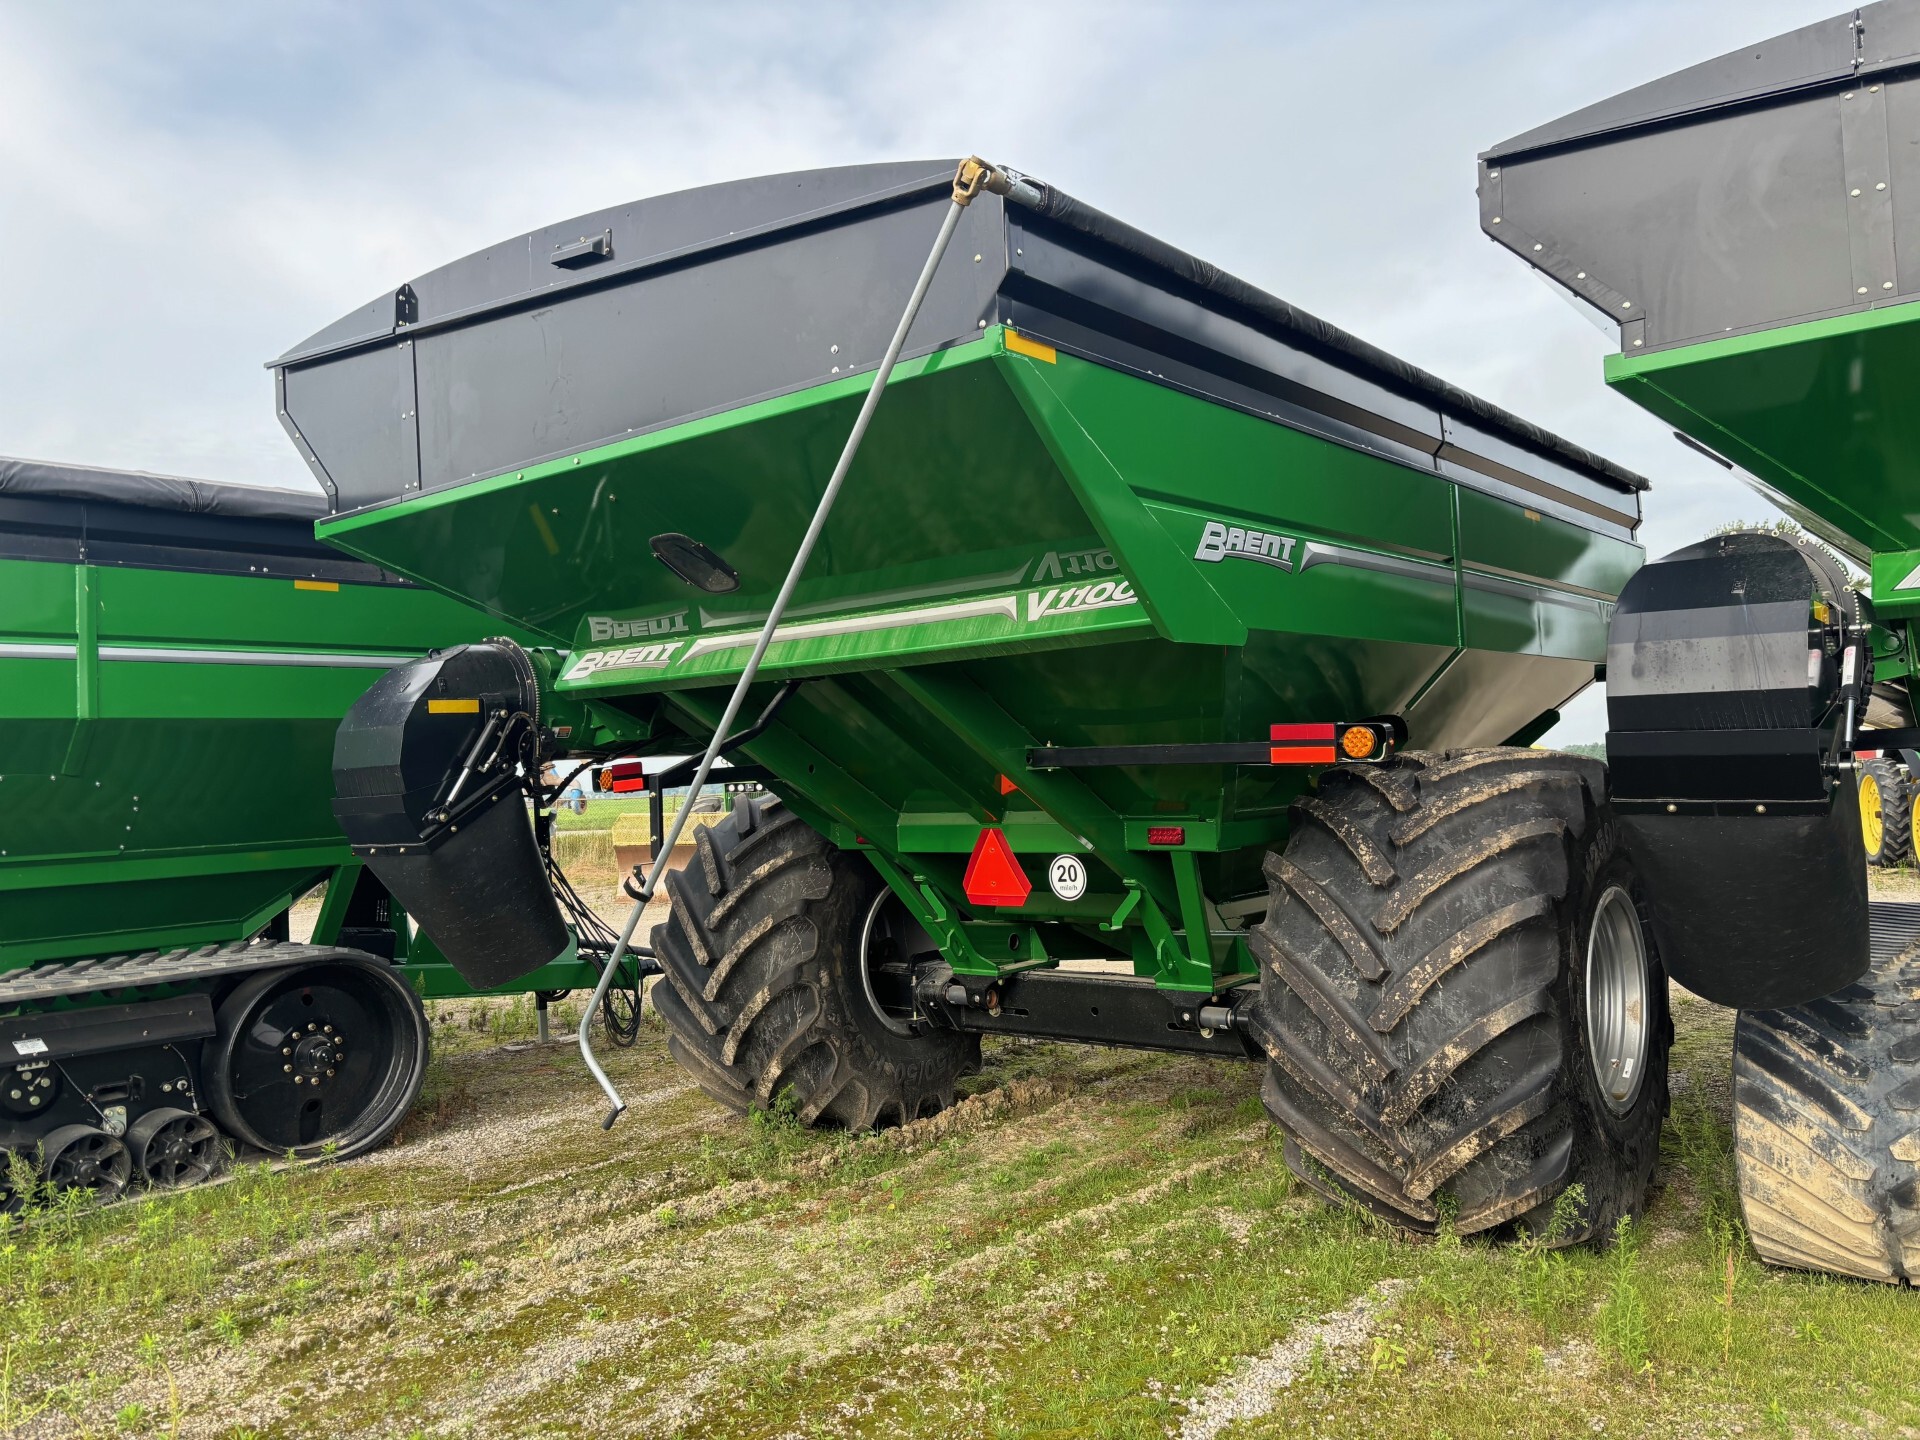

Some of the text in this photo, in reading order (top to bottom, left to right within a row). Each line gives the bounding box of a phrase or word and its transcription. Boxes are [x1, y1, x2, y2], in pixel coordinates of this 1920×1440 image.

[1193, 521, 1297, 565] BRENT
[562, 641, 685, 681] BRENT
[1057, 864, 1078, 883] 20
